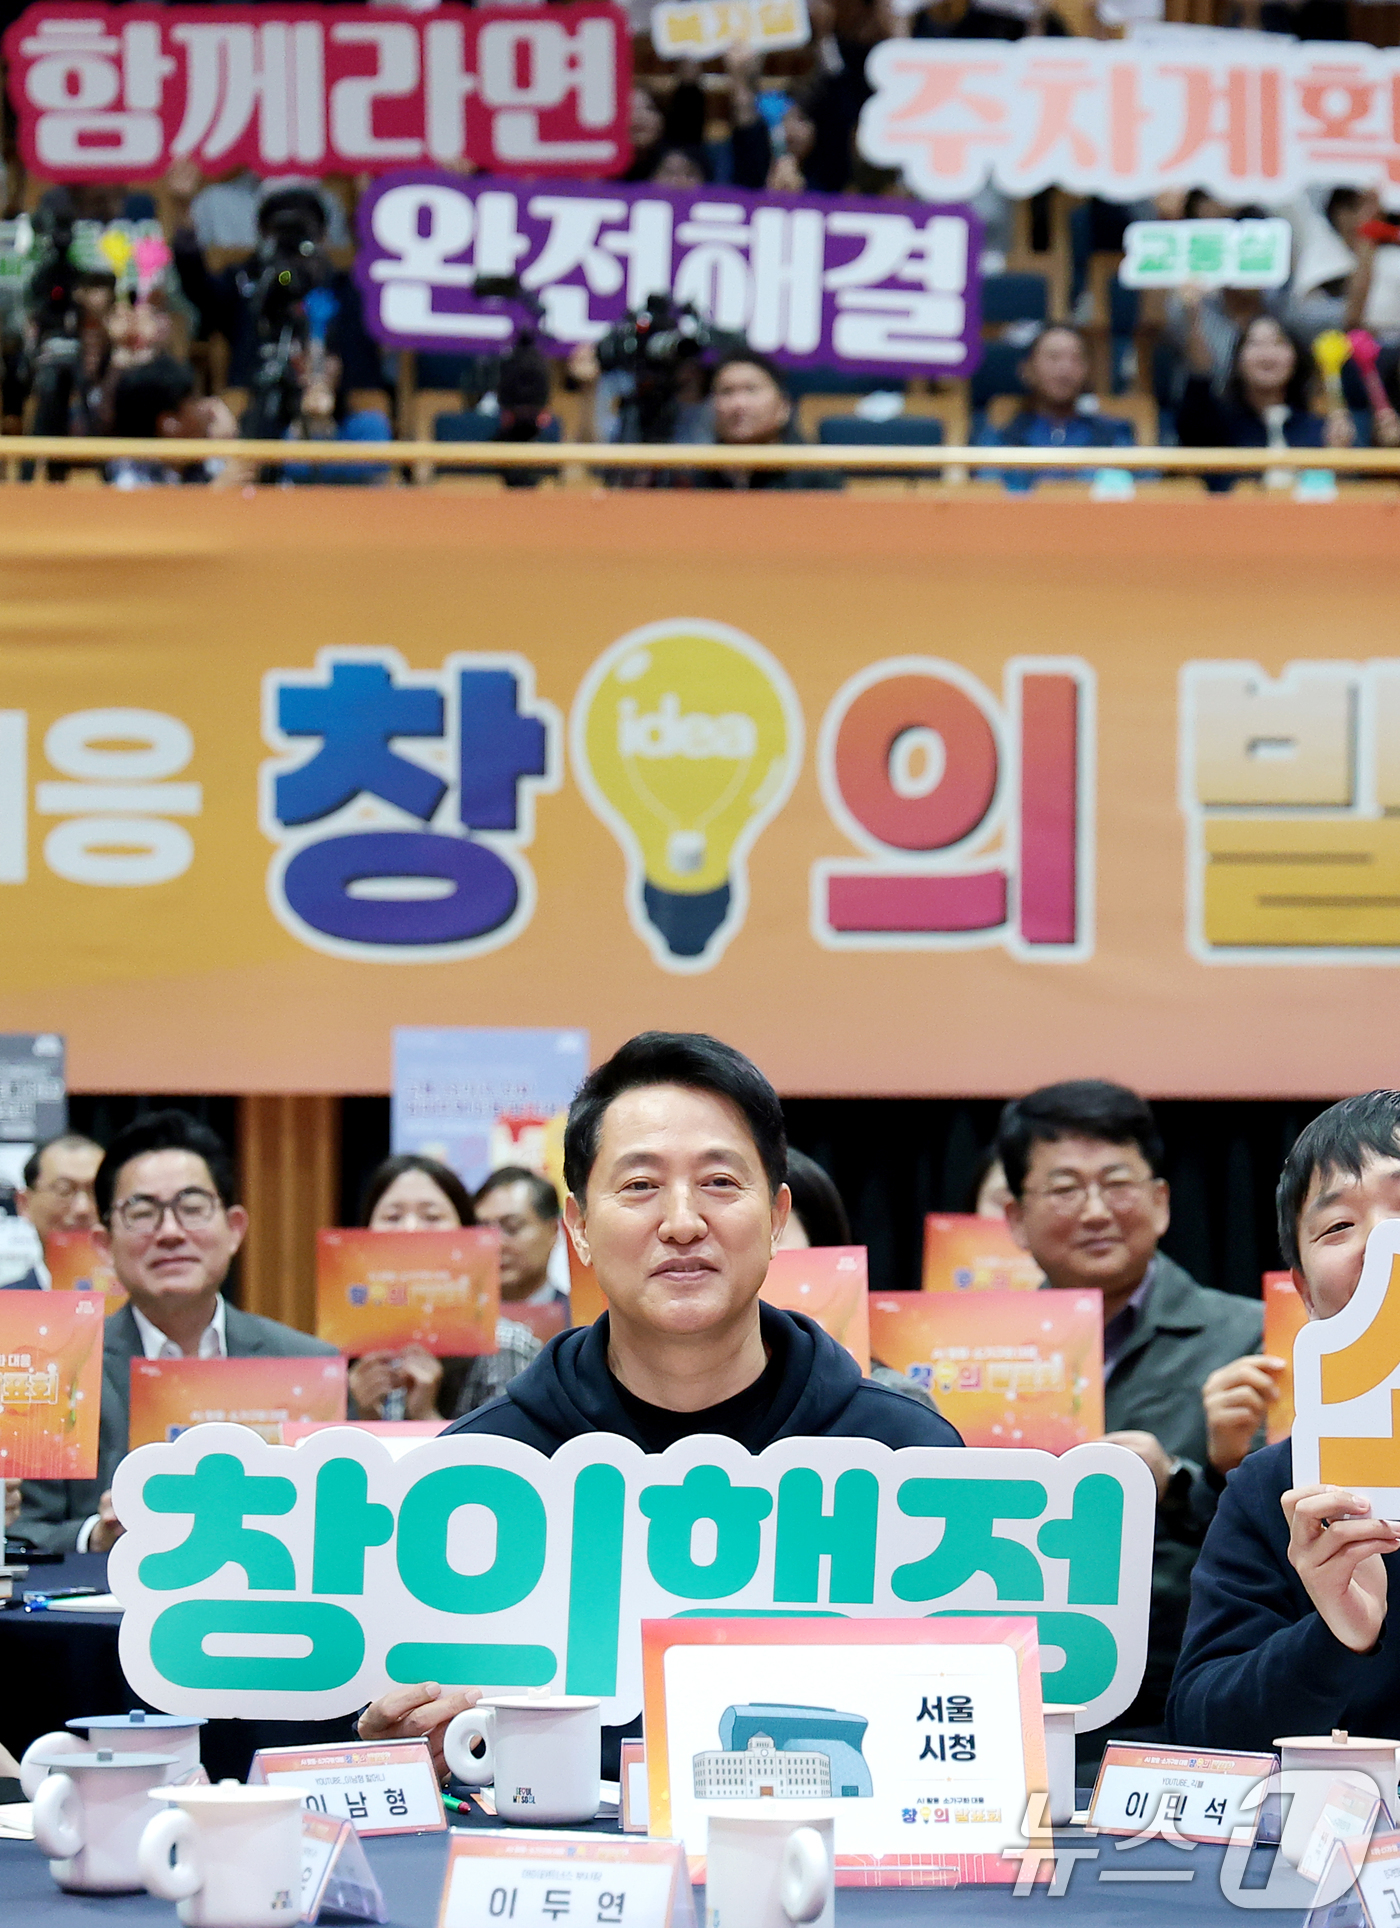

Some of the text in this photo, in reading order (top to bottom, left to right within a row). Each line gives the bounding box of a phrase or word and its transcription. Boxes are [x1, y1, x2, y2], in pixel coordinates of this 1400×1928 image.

[20, 18, 619, 168] 함께라면
[886, 57, 1400, 183] 주차계획
[370, 185, 969, 364] 완전해결
[617, 692, 758, 760] idea
[0, 708, 203, 887] 응
[138, 1453, 1125, 1705] 창의행정
[916, 1695, 974, 1724] 서울
[918, 1733, 977, 1762] 시청
[916, 1797, 925, 1805] AI
